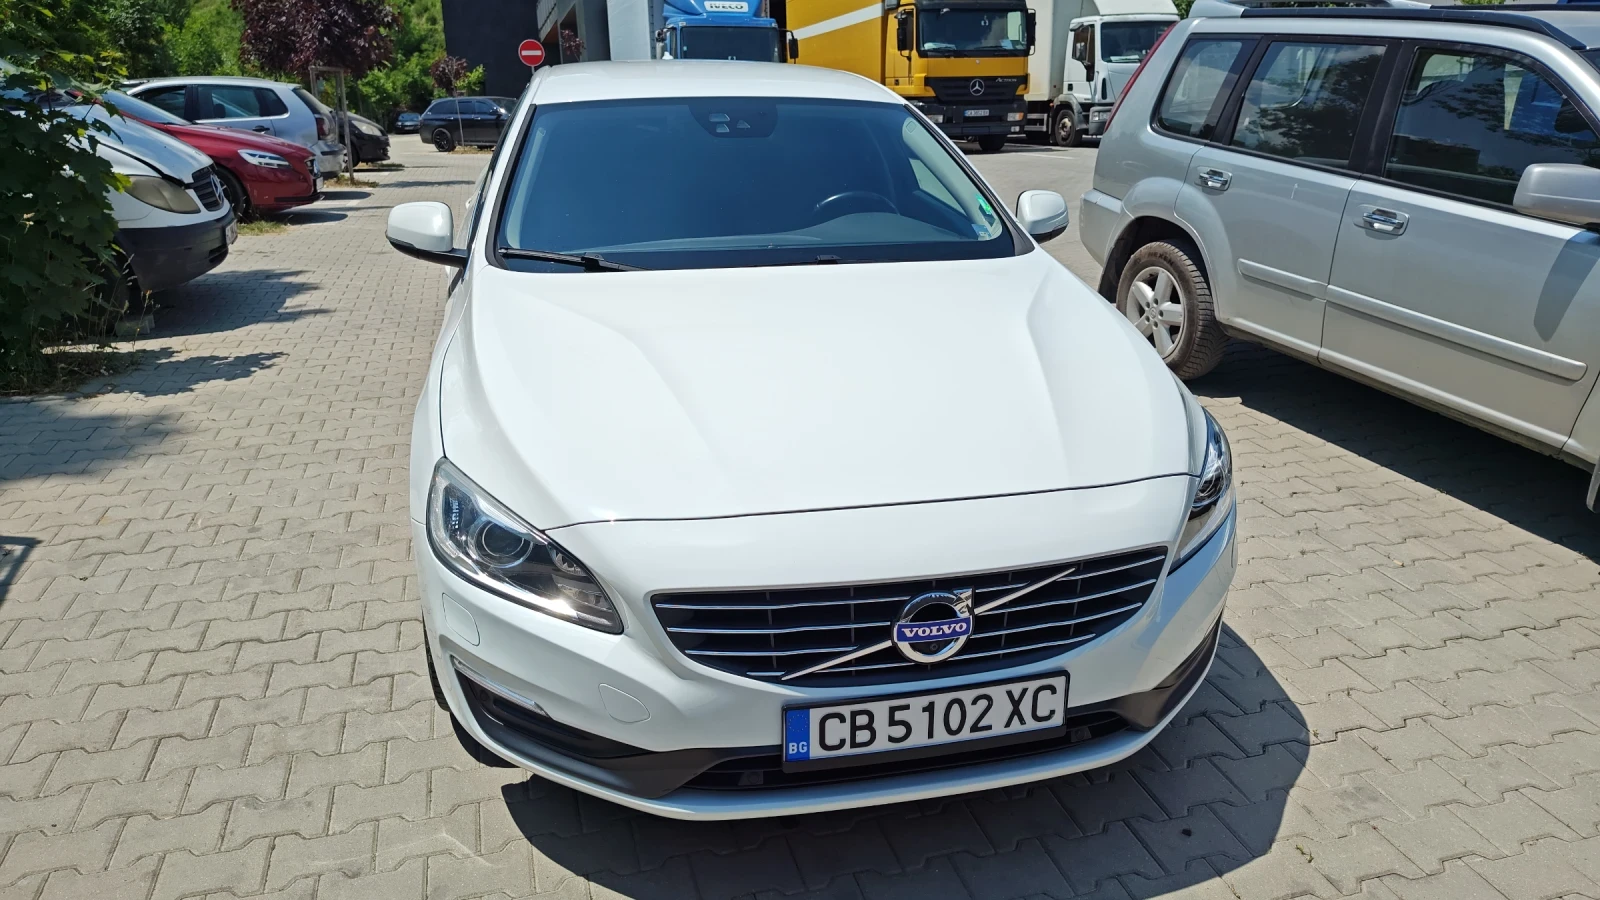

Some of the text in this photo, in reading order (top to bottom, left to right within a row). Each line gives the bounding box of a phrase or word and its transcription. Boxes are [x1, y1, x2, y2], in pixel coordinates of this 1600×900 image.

[901, 622, 967, 638] VOLVO
[818, 684, 1058, 752] CB 5102 XC
[788, 741, 808, 754] BG
